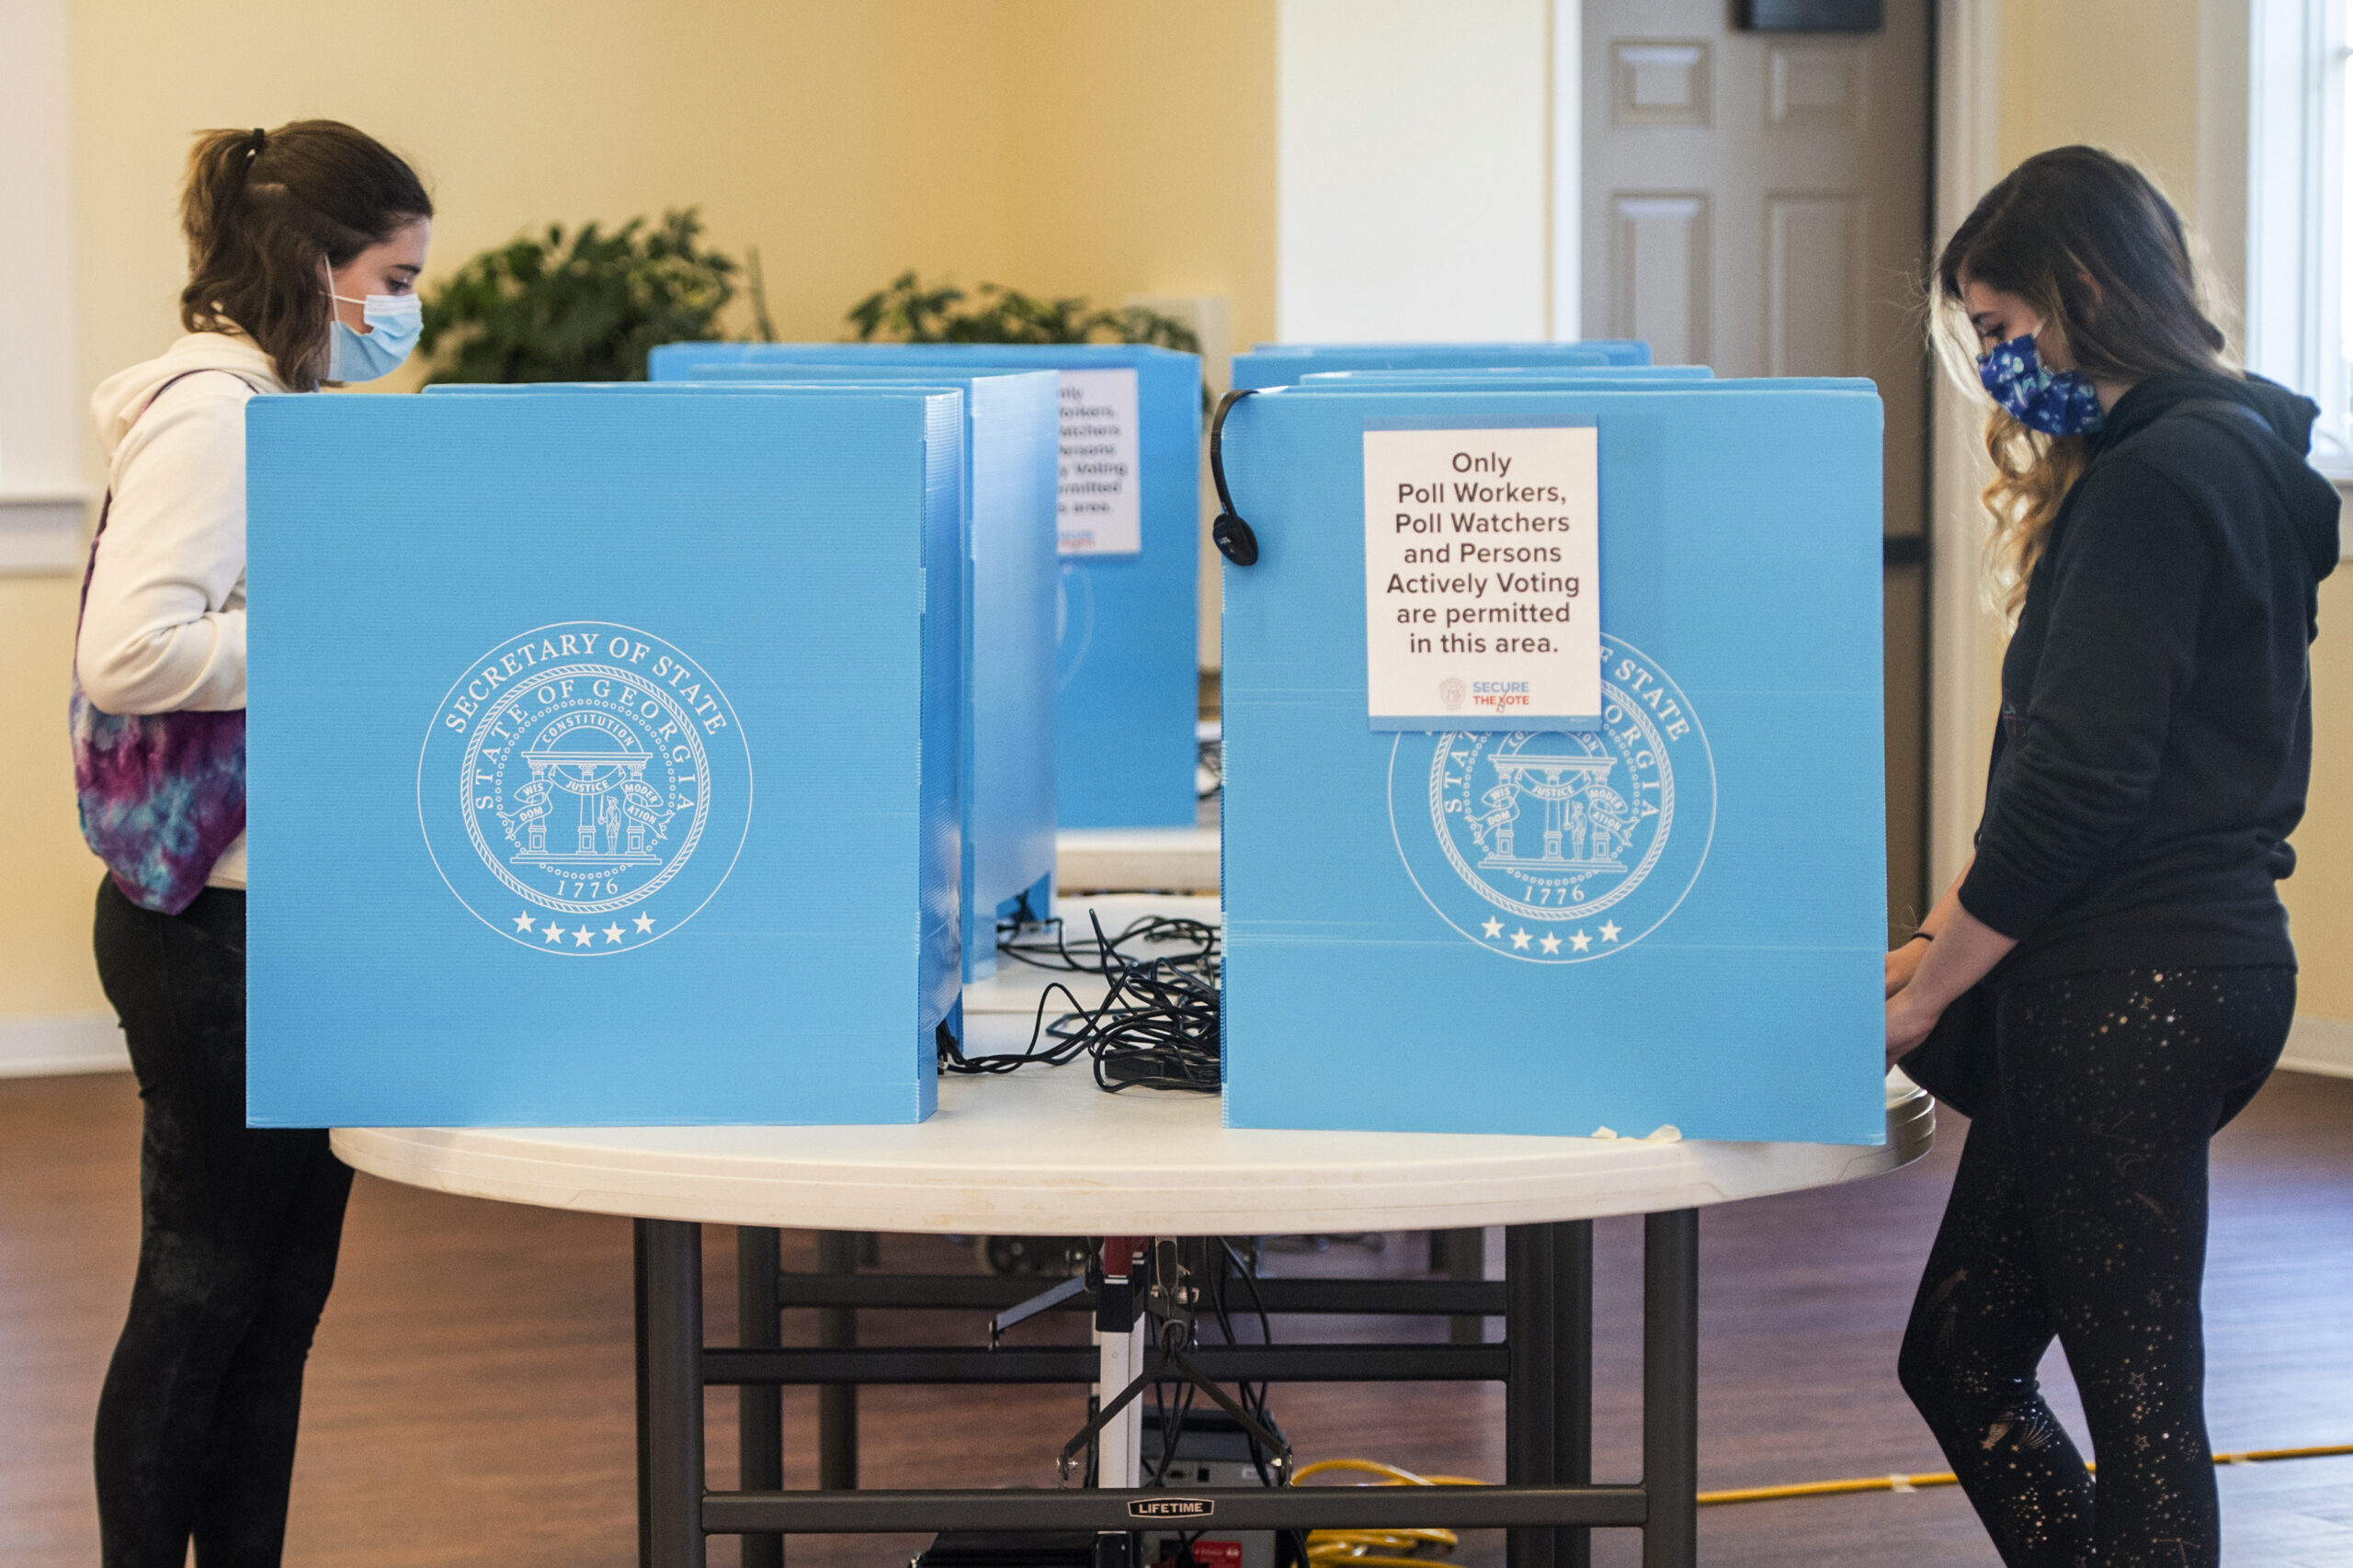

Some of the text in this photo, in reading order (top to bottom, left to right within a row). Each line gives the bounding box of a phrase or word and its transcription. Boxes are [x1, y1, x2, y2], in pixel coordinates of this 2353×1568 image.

[1451, 451, 1512, 478] Only
[1398, 482, 1566, 505] Poll Workers,
[1395, 512, 1570, 534] Poll Watchers
[1404, 542, 1562, 564] and Persons
[1386, 572, 1579, 599] Actively Voting
[1397, 602, 1570, 629] are permitted
[1410, 632, 1558, 653] in this area.
[446, 634, 727, 735] SECRETARY OF STATE
[1472, 681, 1529, 693] SECURE
[1472, 695, 1496, 706] THE
[1614, 659, 1690, 742] STATE
[542, 714, 634, 746] CONSTITUTION
[476, 679, 696, 811] STATE OF GEORGIA
[1605, 704, 1660, 818] ORGIA
[522, 782, 544, 797] WIS
[566, 780, 609, 792] JUSTICE
[625, 783, 658, 803] MODER
[1531, 783, 1574, 797] JUSTICE
[1589, 789, 1623, 809] MODER
[519, 806, 543, 822] DOM
[627, 805, 657, 824] ATION
[1487, 810, 1511, 825] DOM
[1593, 811, 1622, 831] ATION
[556, 879, 620, 899] 1776
[1524, 884, 1585, 905] 1776
[1138, 1502, 1203, 1514] LIFETIME
